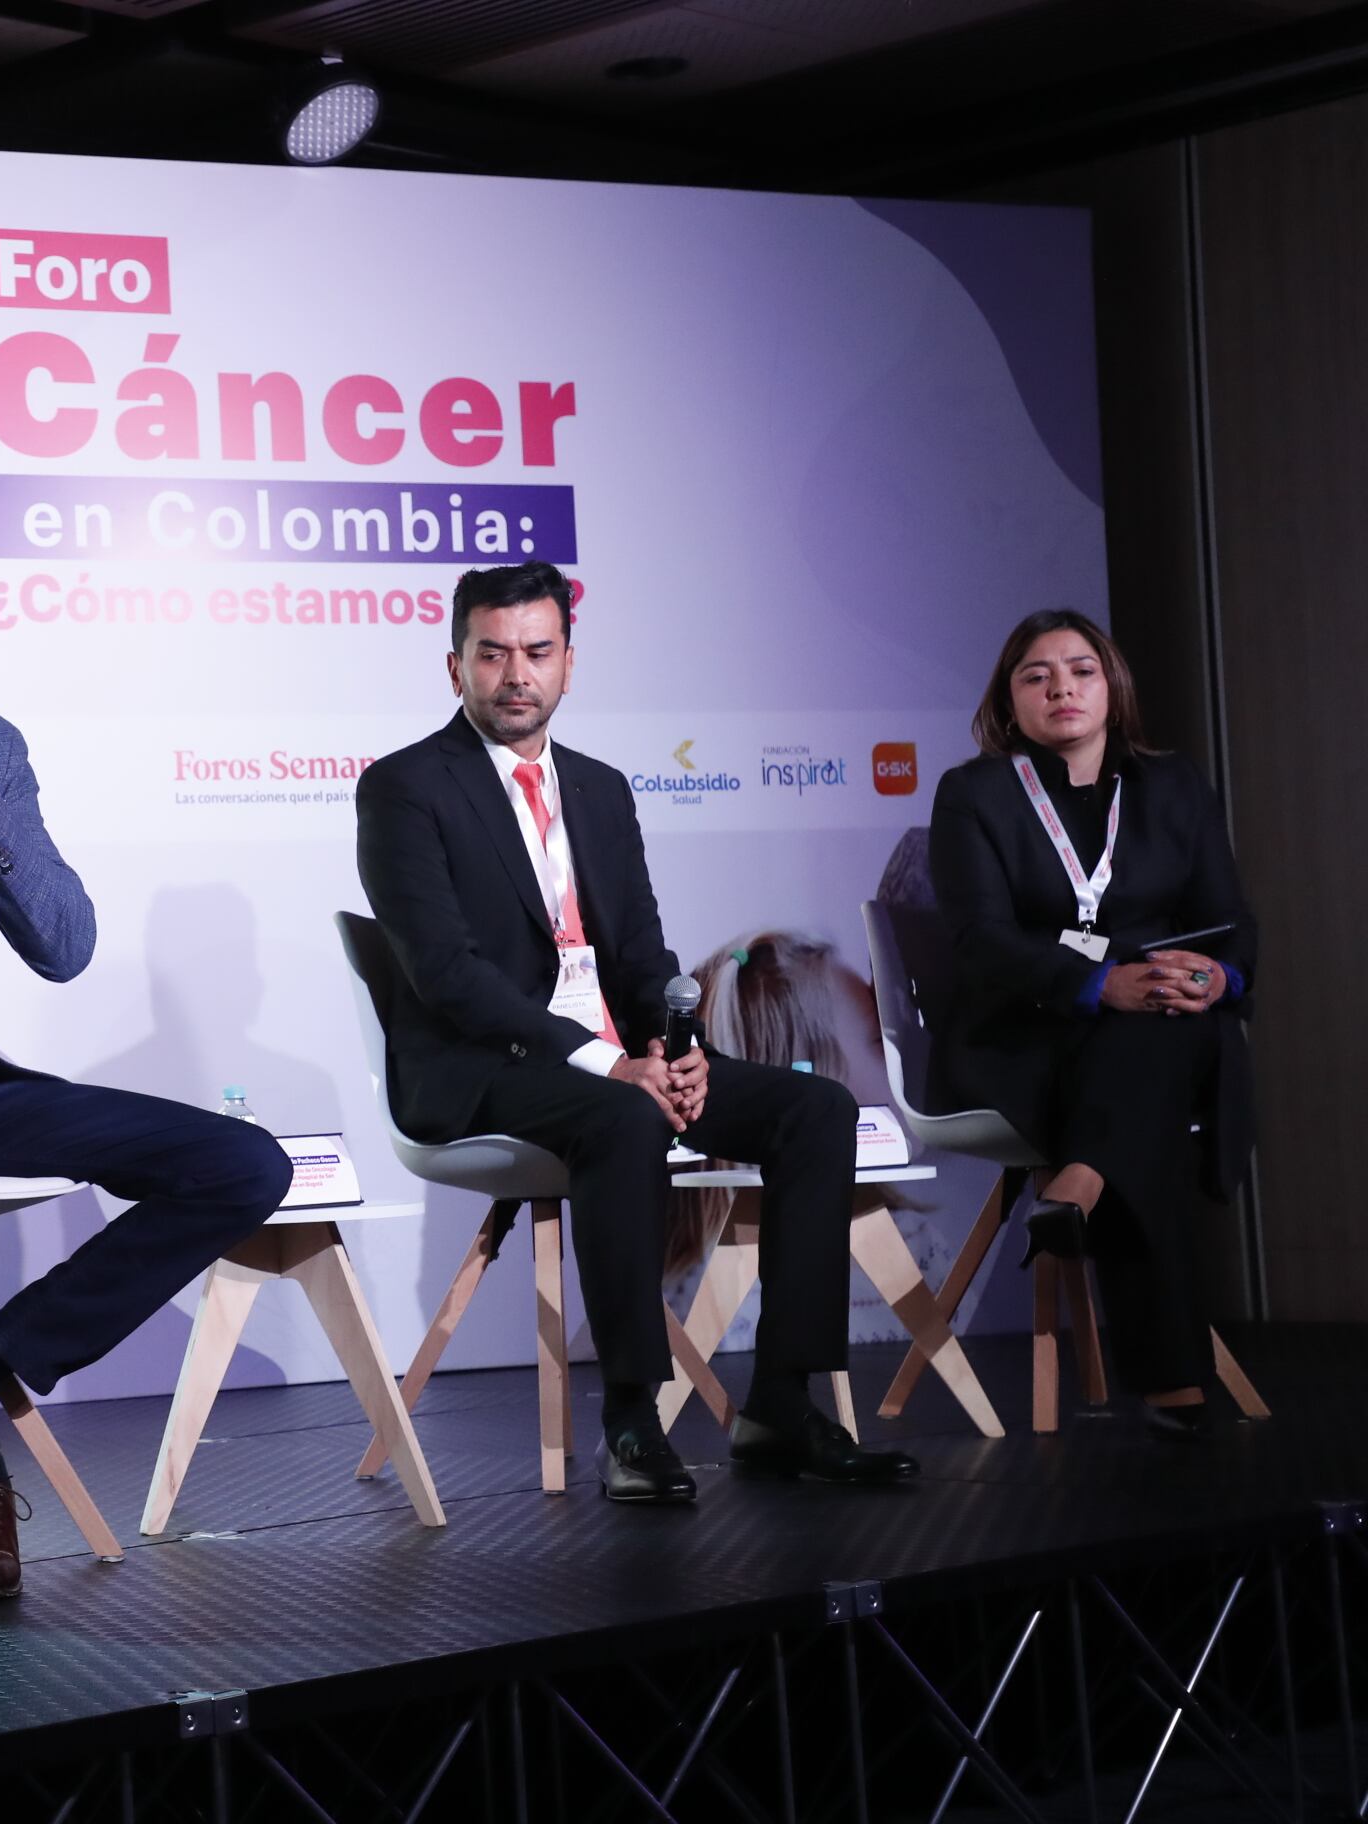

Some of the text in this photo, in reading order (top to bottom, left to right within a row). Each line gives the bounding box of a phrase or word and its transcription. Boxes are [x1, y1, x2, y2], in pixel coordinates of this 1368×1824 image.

[23, 490, 535, 553] en Colombia:
[208, 578, 444, 625] estamos
[174, 750, 261, 780] Foros
[876, 761, 912, 777] GSK
[631, 773, 741, 792] Colsubsidio
[175, 791, 195, 804] Las
[198, 790, 287, 803] conversaciones
[289, 793, 311, 805] que
[313, 790, 323, 802] el
[326, 789, 349, 804] país
[672, 794, 702, 805] Salud
